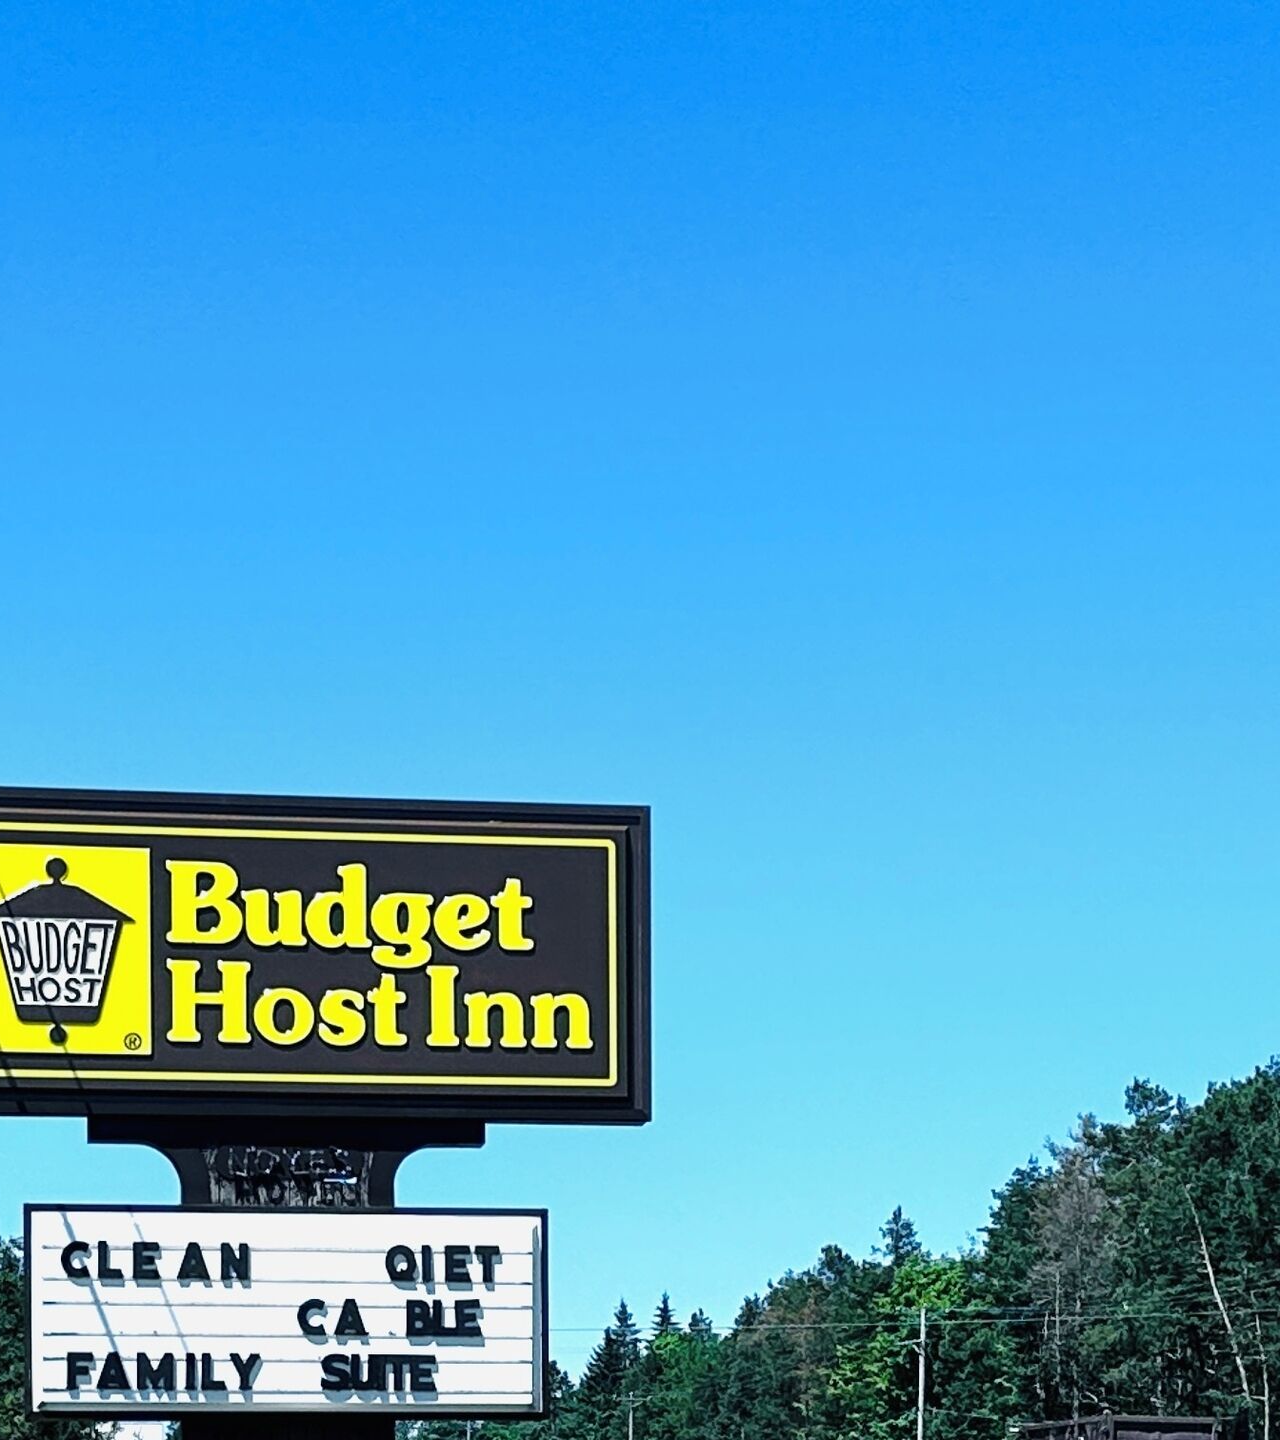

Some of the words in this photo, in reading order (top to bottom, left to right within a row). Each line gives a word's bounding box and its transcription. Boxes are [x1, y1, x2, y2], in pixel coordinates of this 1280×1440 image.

[165, 859, 535, 969] Budget
[1, 920, 114, 975] BUDGET
[13, 976, 102, 1003] HOST
[165, 958, 408, 1048] Host
[425, 964, 594, 1050] Inn
[61, 1240, 250, 1280] CLEAN
[385, 1244, 500, 1284] QIET
[66, 1352, 261, 1391] FAMILY
[321, 1353, 437, 1392] SUITE
